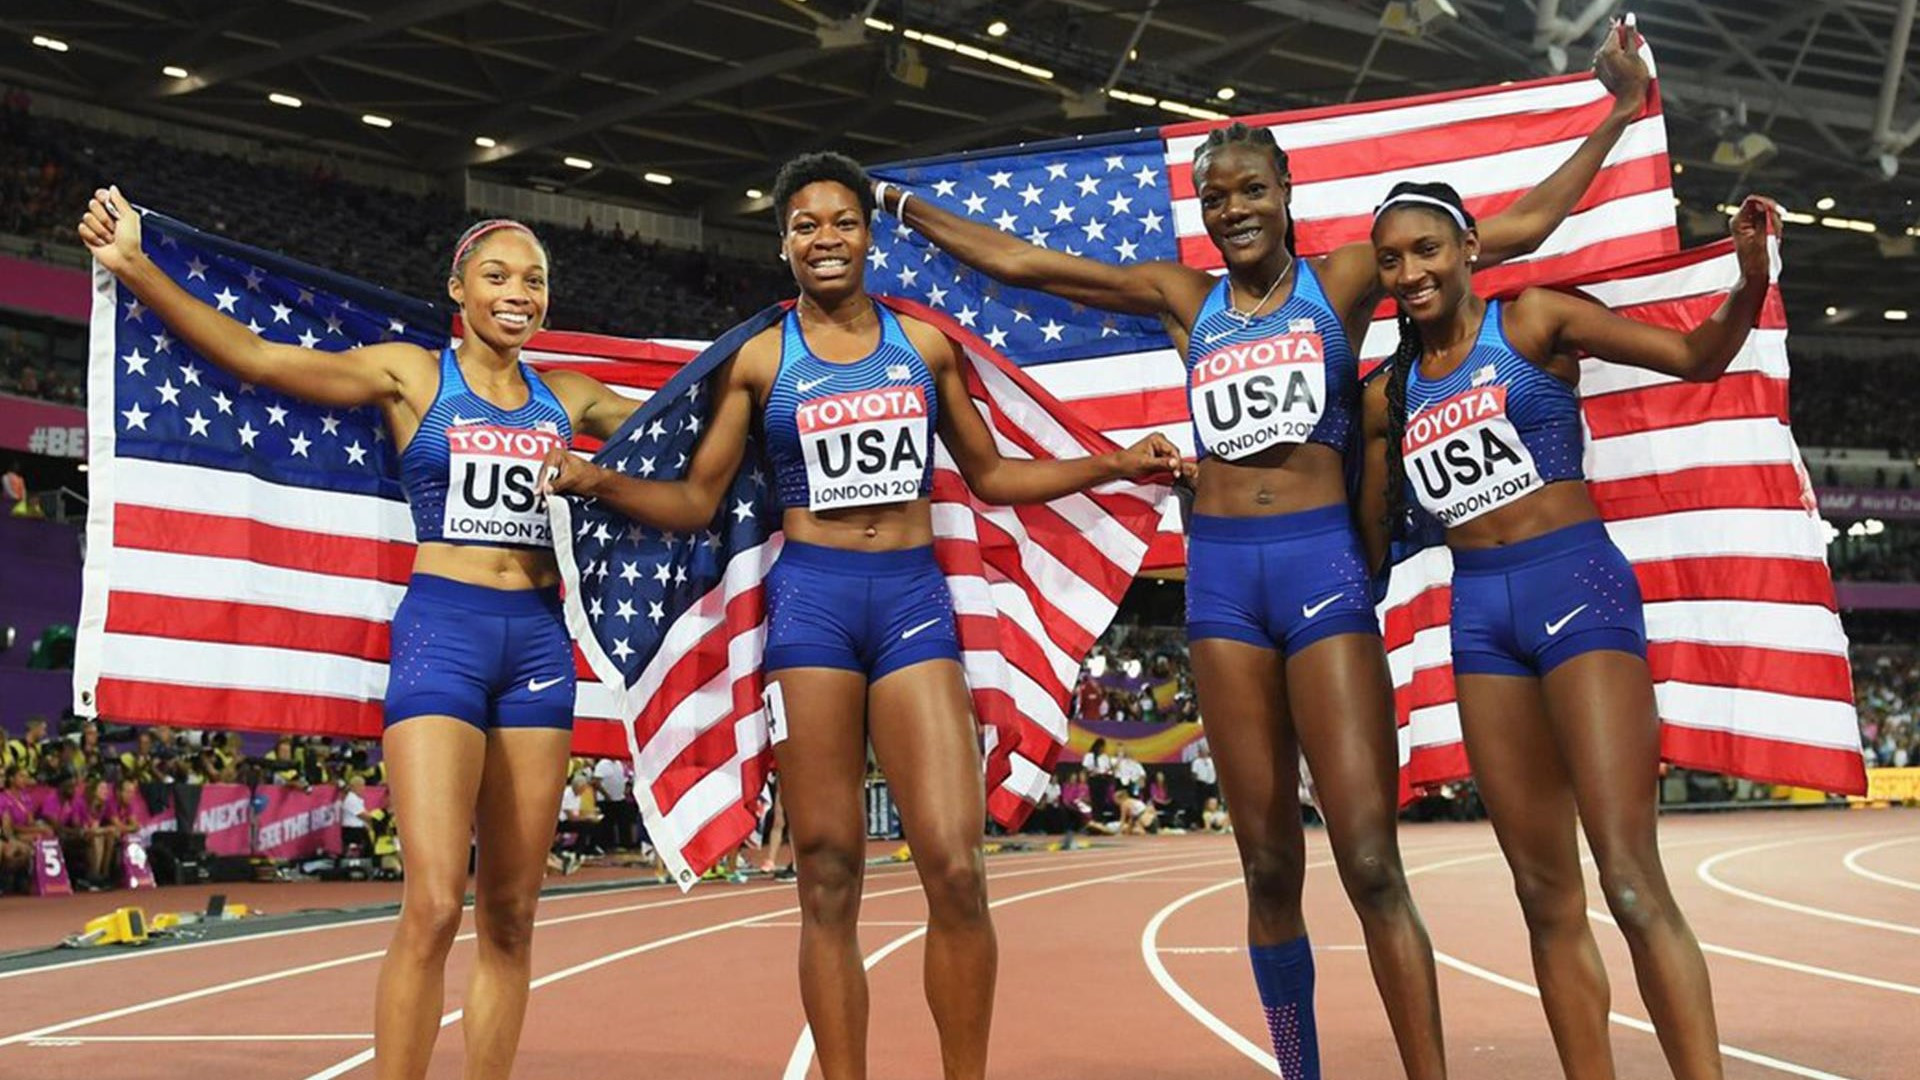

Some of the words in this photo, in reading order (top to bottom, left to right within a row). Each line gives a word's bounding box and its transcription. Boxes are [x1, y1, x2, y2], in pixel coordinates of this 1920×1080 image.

[1194, 337, 1317, 383] TOYOTA
[799, 391, 922, 429] TOYOTA
[1204, 370, 1317, 431] USA
[1406, 391, 1498, 449] TOYOTA
[449, 430, 564, 455] TOYOT
[816, 426, 923, 478] USA
[1414, 427, 1522, 499] USA
[815, 483, 888, 503] LONDON
[1438, 491, 1491, 524] ONDON
[1492, 473, 1531, 500] 2017
[450, 518, 532, 539] LONDON
[258, 822, 282, 849] SEE
[283, 811, 310, 842] THE
[43, 847, 61, 877] 5
